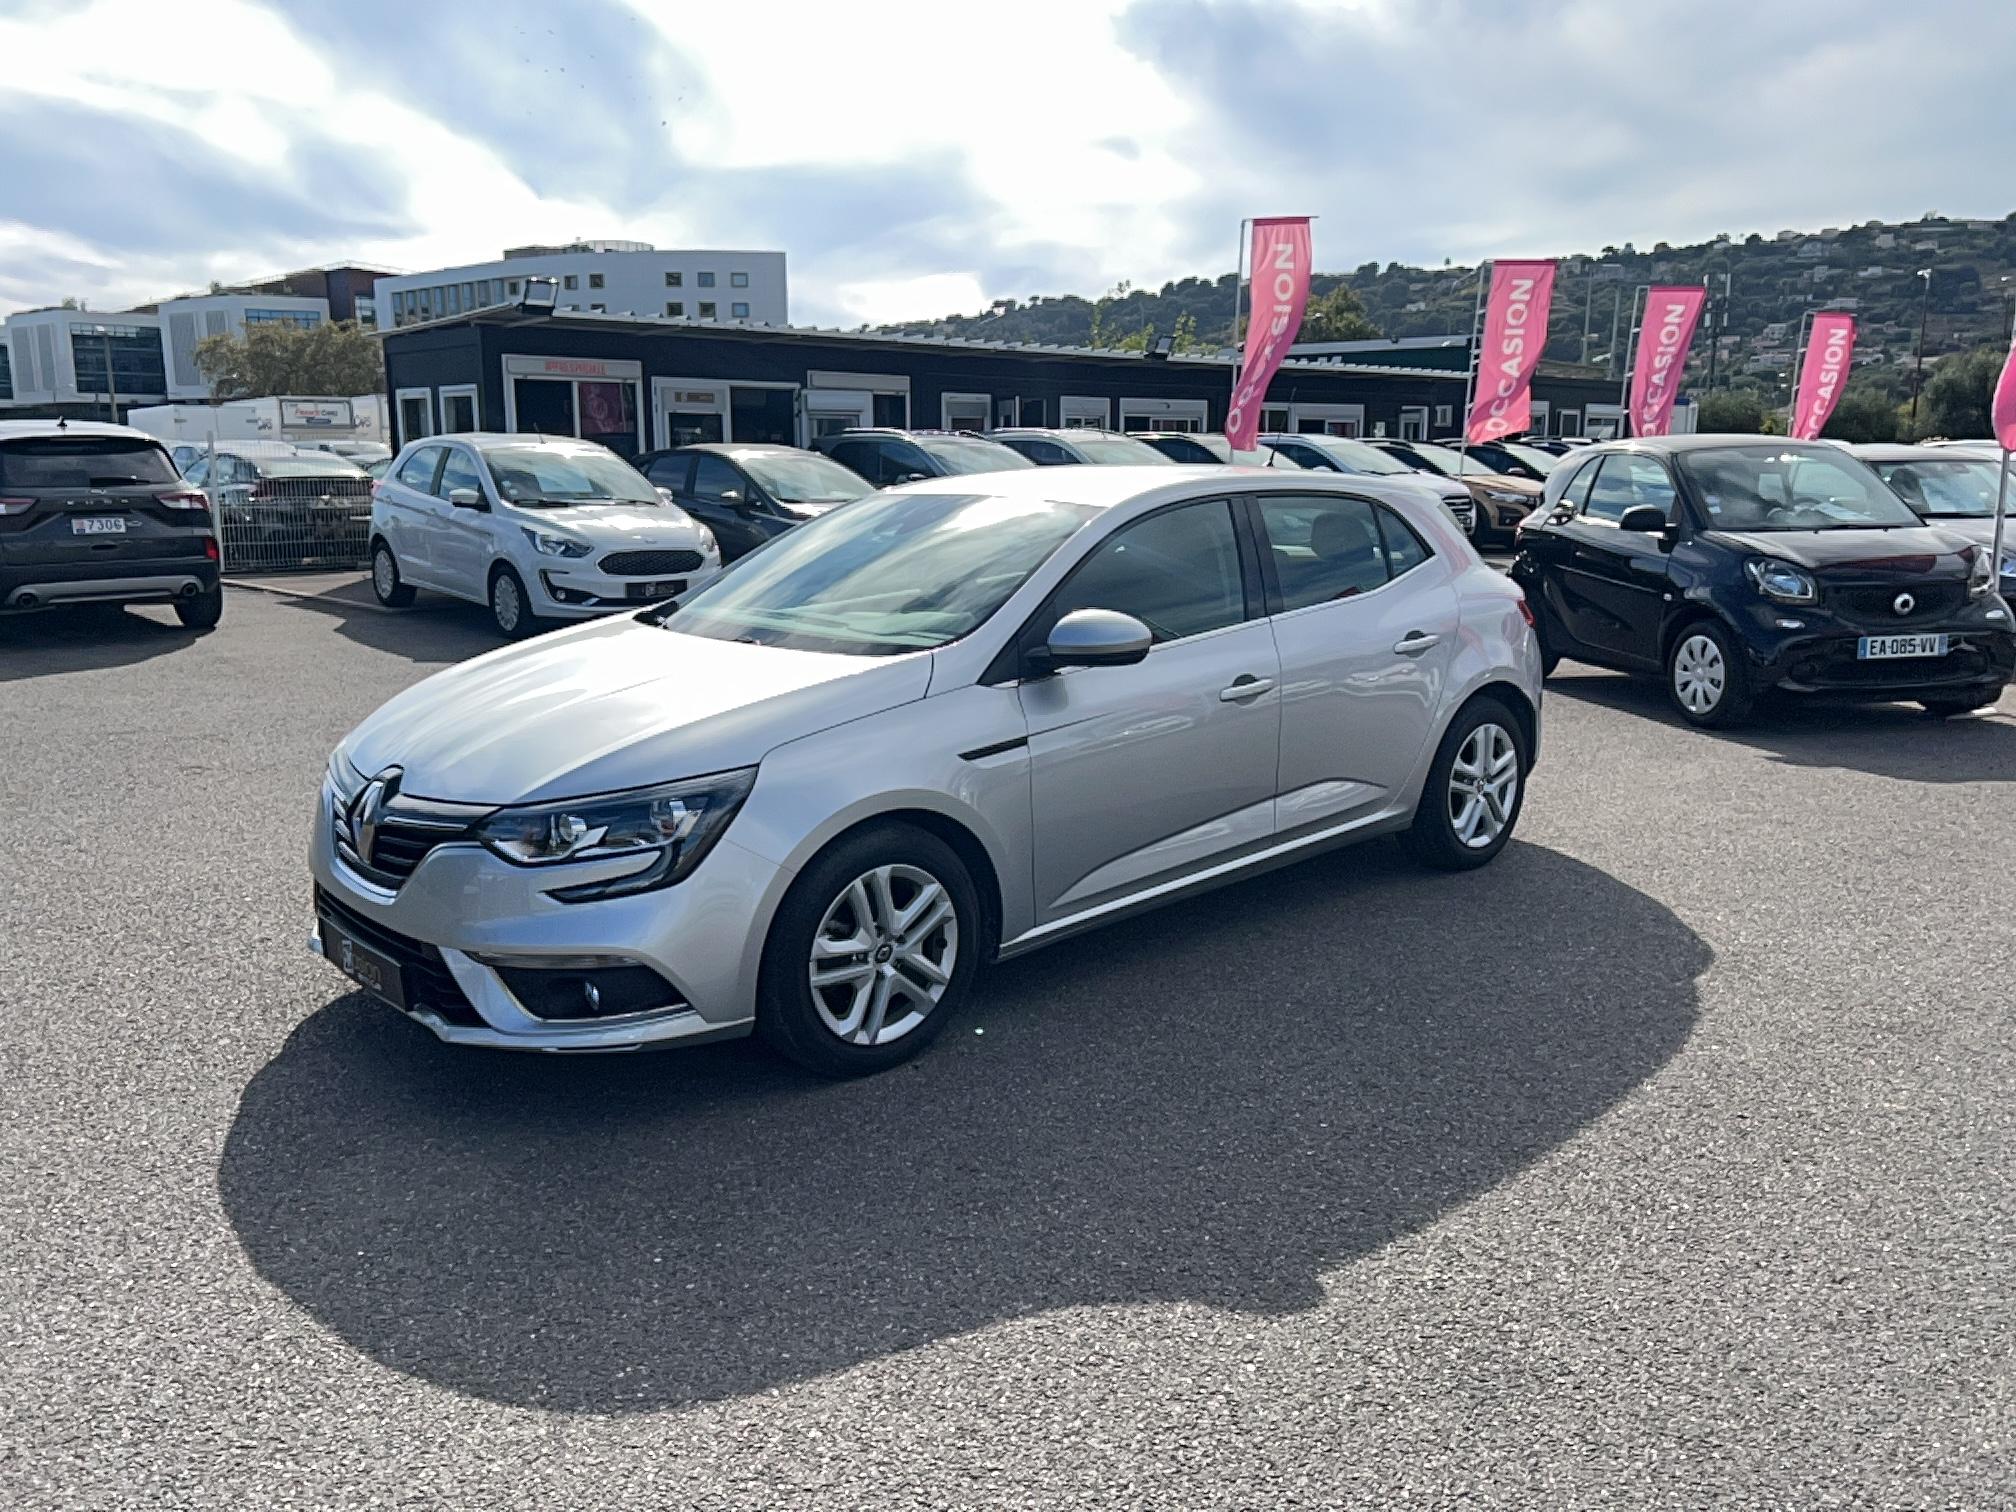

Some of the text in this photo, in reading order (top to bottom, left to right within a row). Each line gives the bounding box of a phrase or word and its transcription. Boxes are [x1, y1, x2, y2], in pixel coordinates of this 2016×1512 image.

[1485, 278, 1534, 433] OCCASION
[88, 519, 123, 530] 7306
[1869, 637, 1937, 656] EA-085-VV
